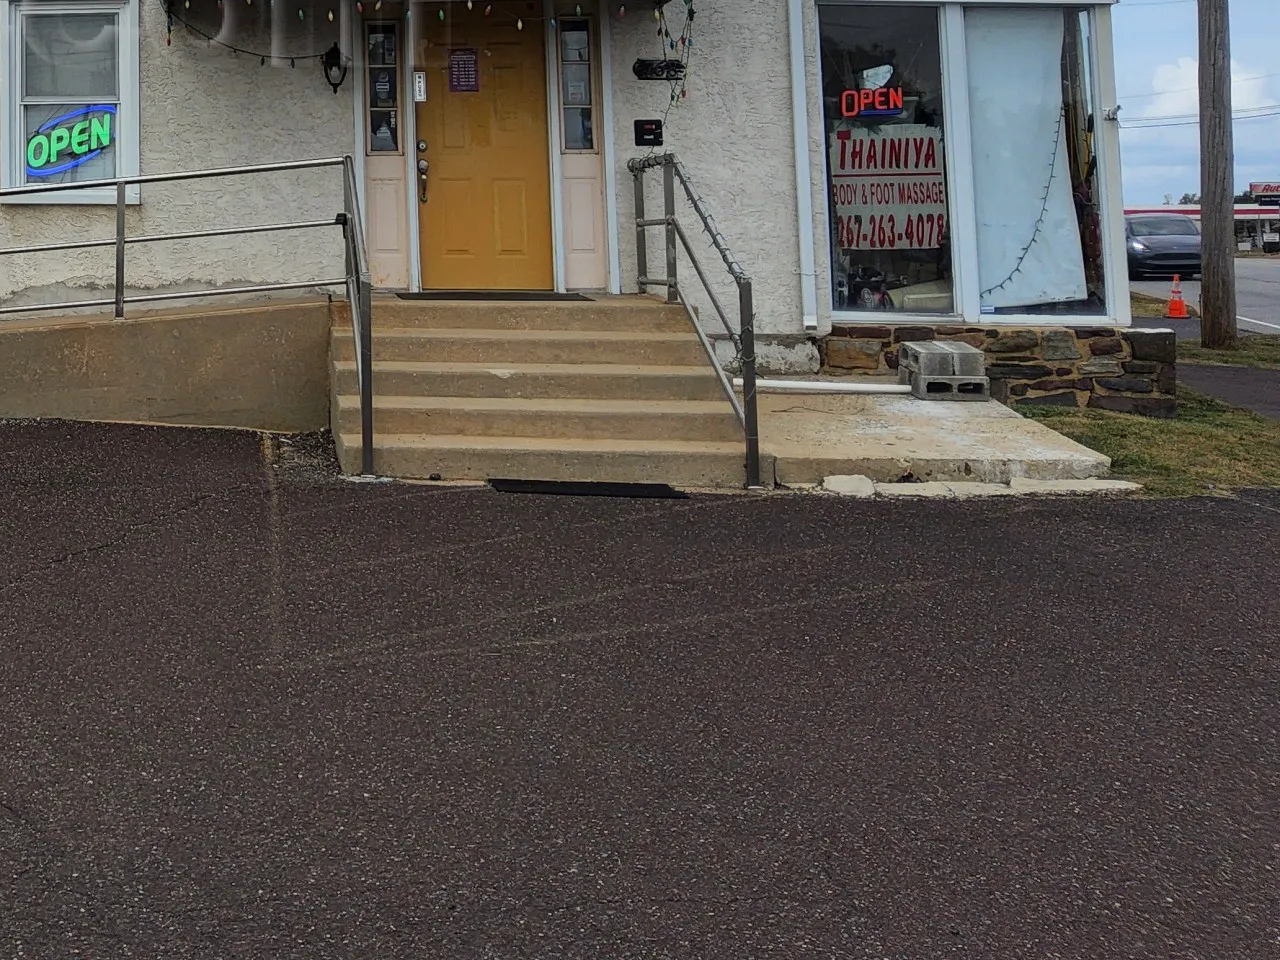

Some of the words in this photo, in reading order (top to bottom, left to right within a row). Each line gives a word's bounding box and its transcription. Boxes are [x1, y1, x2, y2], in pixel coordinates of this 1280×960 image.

[841, 86, 904, 117] OPEN
[27, 113, 111, 168] OPEN
[836, 129, 936, 170] THAINIYA
[833, 183, 858, 206] BODY
[861, 183, 868, 205] &
[870, 182, 895, 204] FOOT
[898, 181, 944, 204] MASSAGE
[837, 213, 944, 248] 267-263-4078
